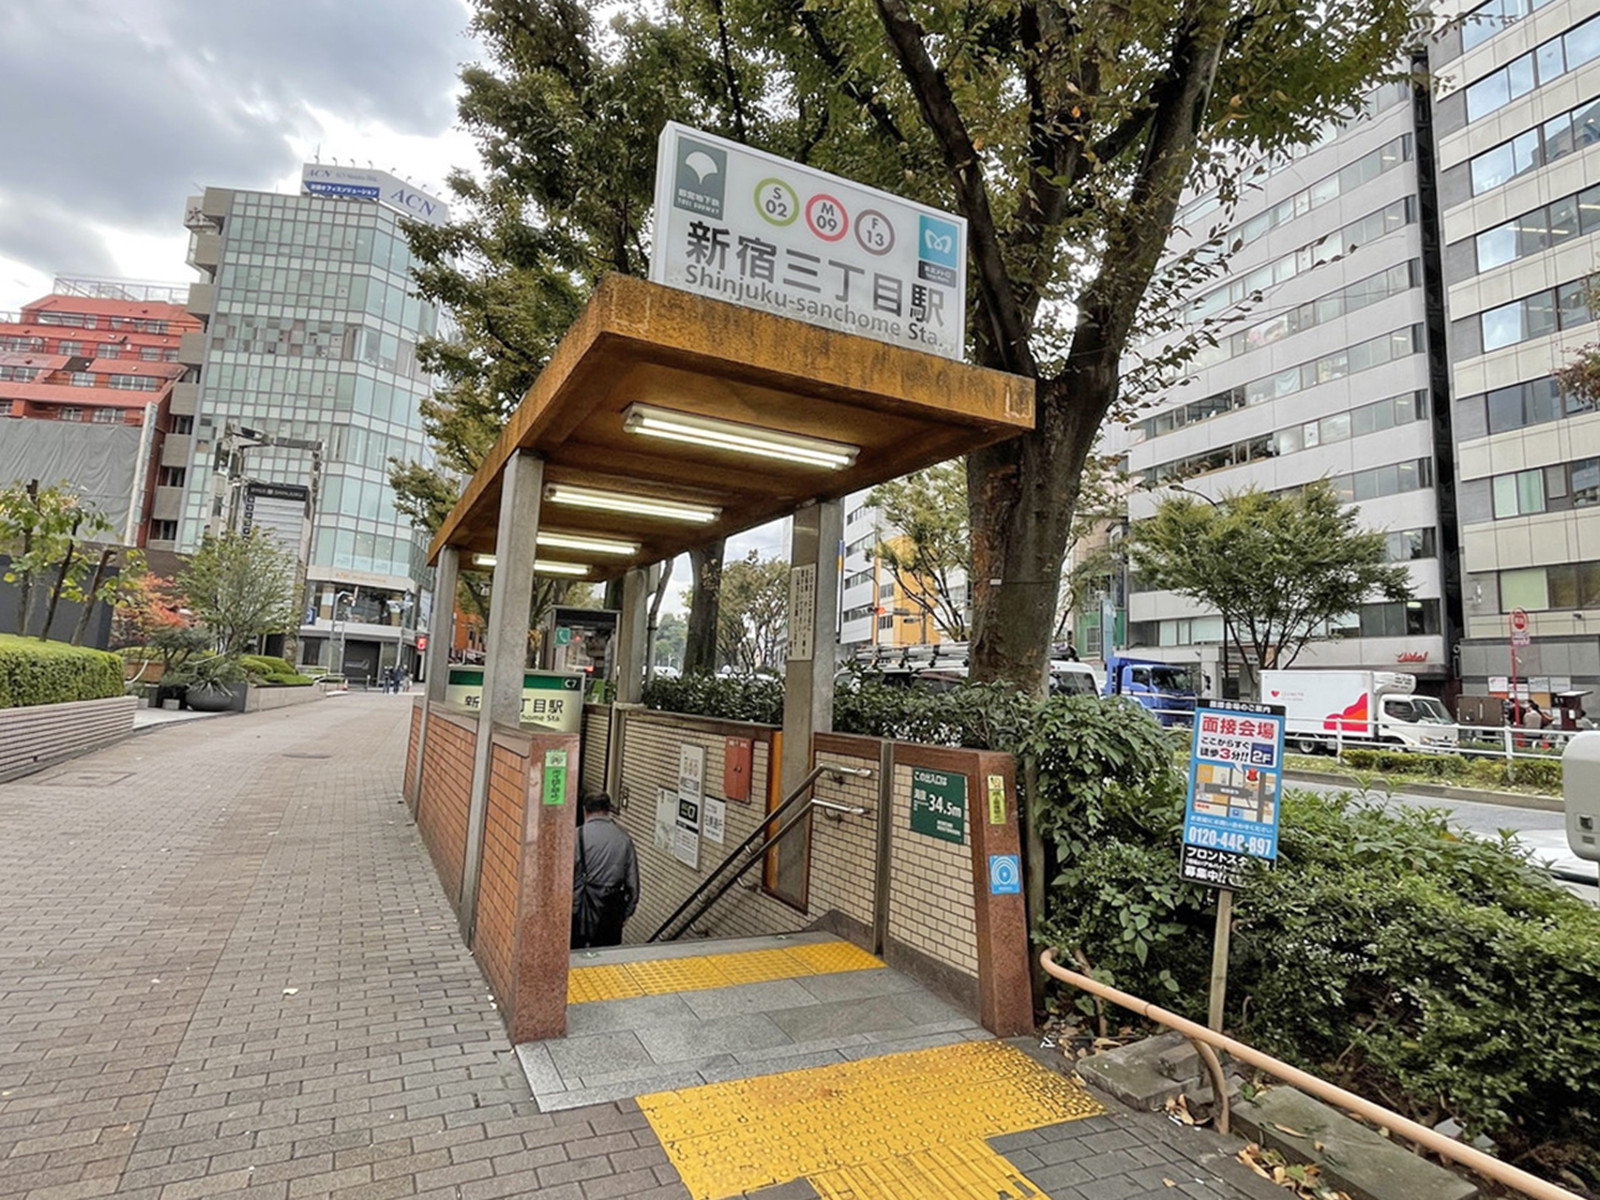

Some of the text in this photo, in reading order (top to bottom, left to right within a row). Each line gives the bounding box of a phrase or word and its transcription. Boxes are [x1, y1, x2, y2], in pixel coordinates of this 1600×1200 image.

[391, 188, 437, 216] ACN
[773, 187, 782, 200] S
[765, 199, 788, 219] 02
[821, 202, 835, 218] M
[816, 214, 838, 233] 09
[871, 217, 879, 230] F
[866, 229, 885, 248] 13
[685, 220, 945, 328] 新宿三丁目駅
[684, 264, 943, 348] Shinjuku-sanchome Sta.
[464, 695, 564, 714] 新丁目駅
[1202, 715, 1275, 740] 面接会場
[1200, 736, 1251, 750] ここからすぐ
[1251, 749, 1272, 764] 2F
[928, 793, 962, 818] 34.5m
